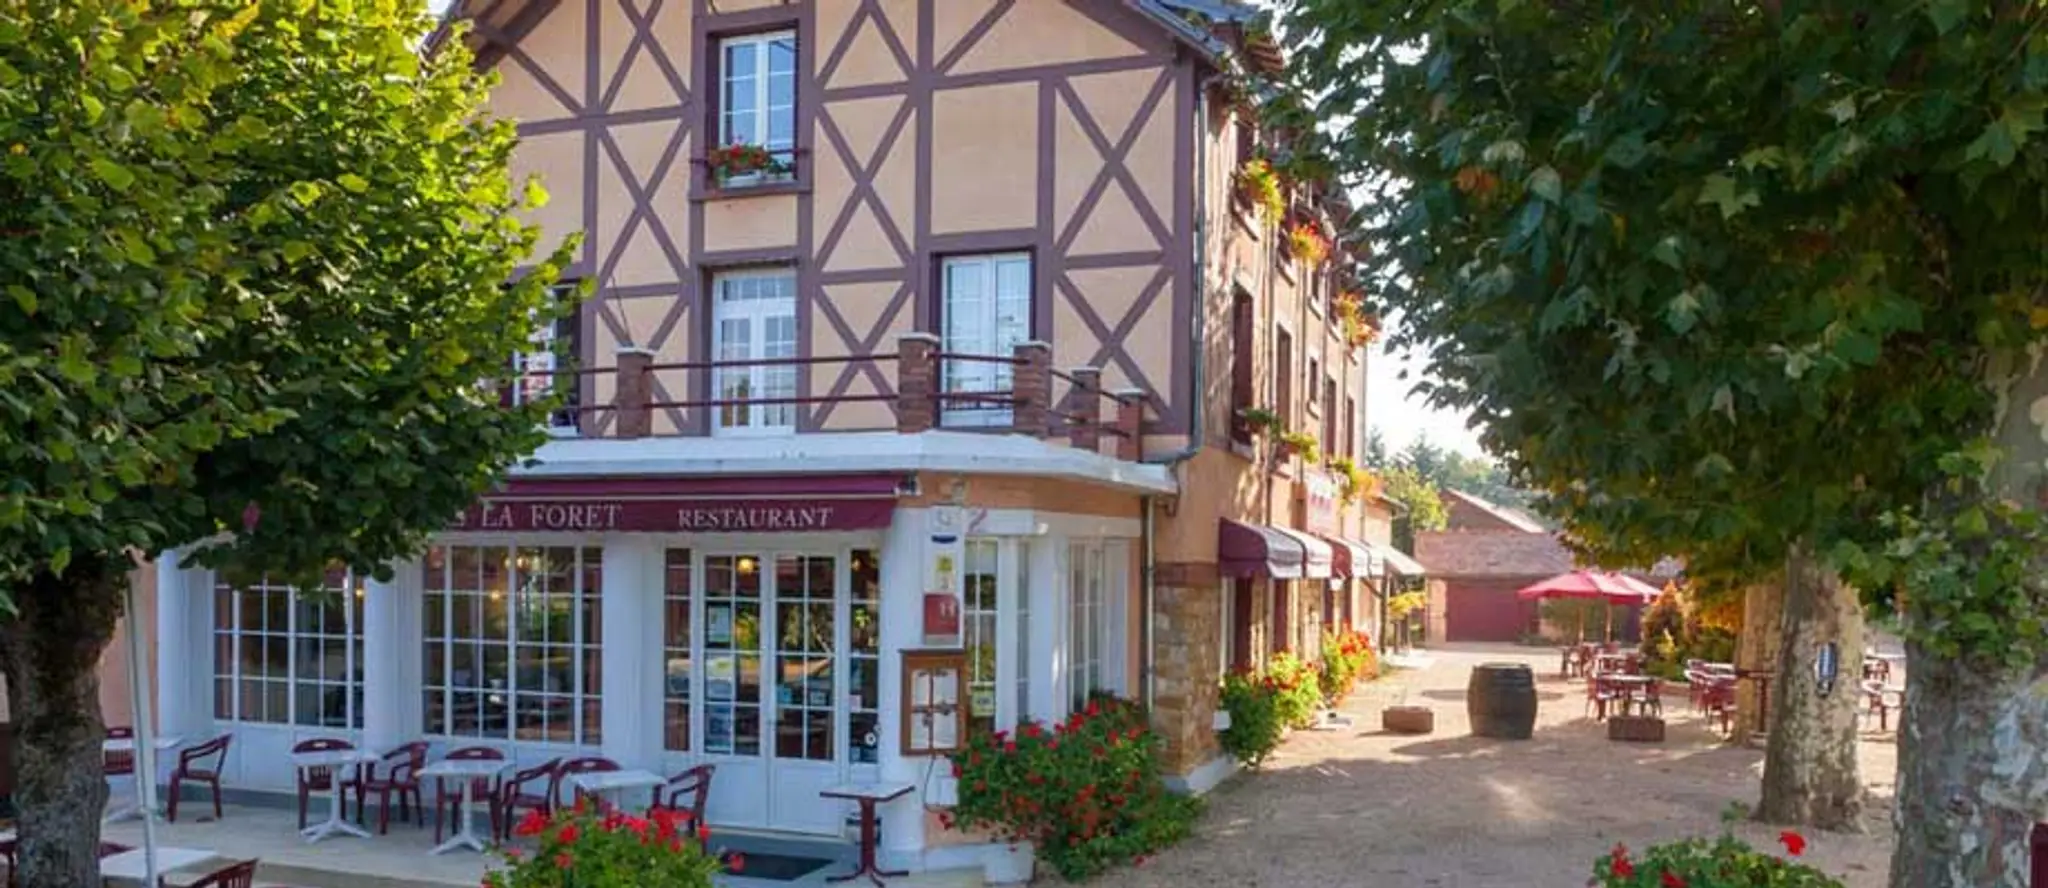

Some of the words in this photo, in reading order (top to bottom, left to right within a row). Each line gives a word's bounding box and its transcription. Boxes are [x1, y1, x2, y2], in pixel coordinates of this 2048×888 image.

[481, 503, 515, 527] LA
[531, 503, 623, 528] FORET
[677, 507, 834, 528] RESTAURANT
